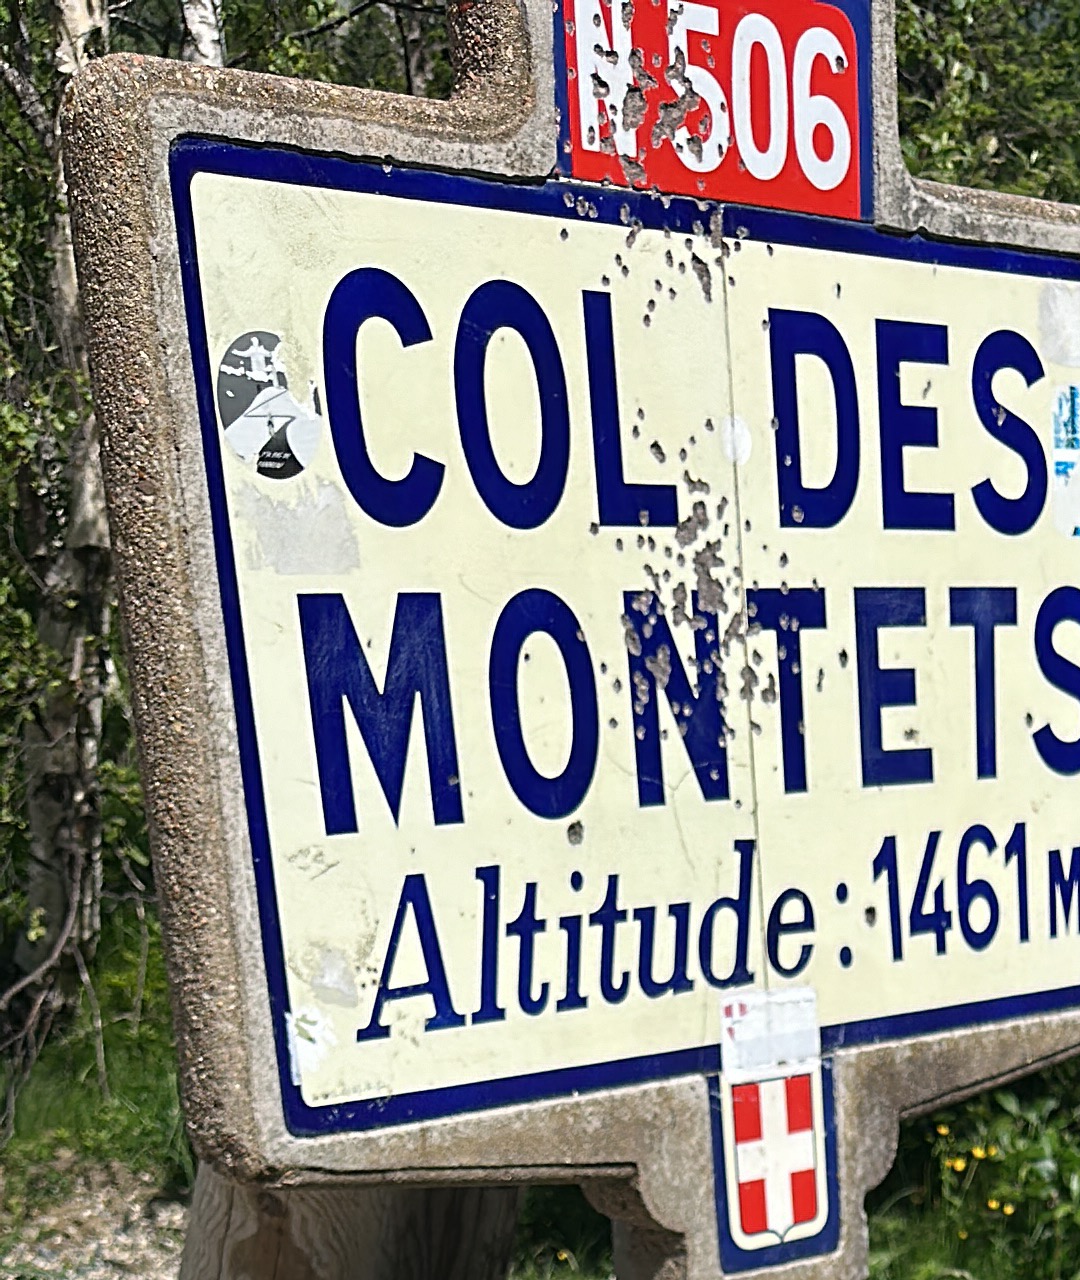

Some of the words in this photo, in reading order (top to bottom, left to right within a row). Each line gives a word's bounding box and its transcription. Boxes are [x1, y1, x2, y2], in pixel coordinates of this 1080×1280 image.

[667, 0, 852, 191] 506
[323, 267, 678, 529] COL
[768, 308, 1049, 536] DES
[873, 822, 1029, 961] 1461
